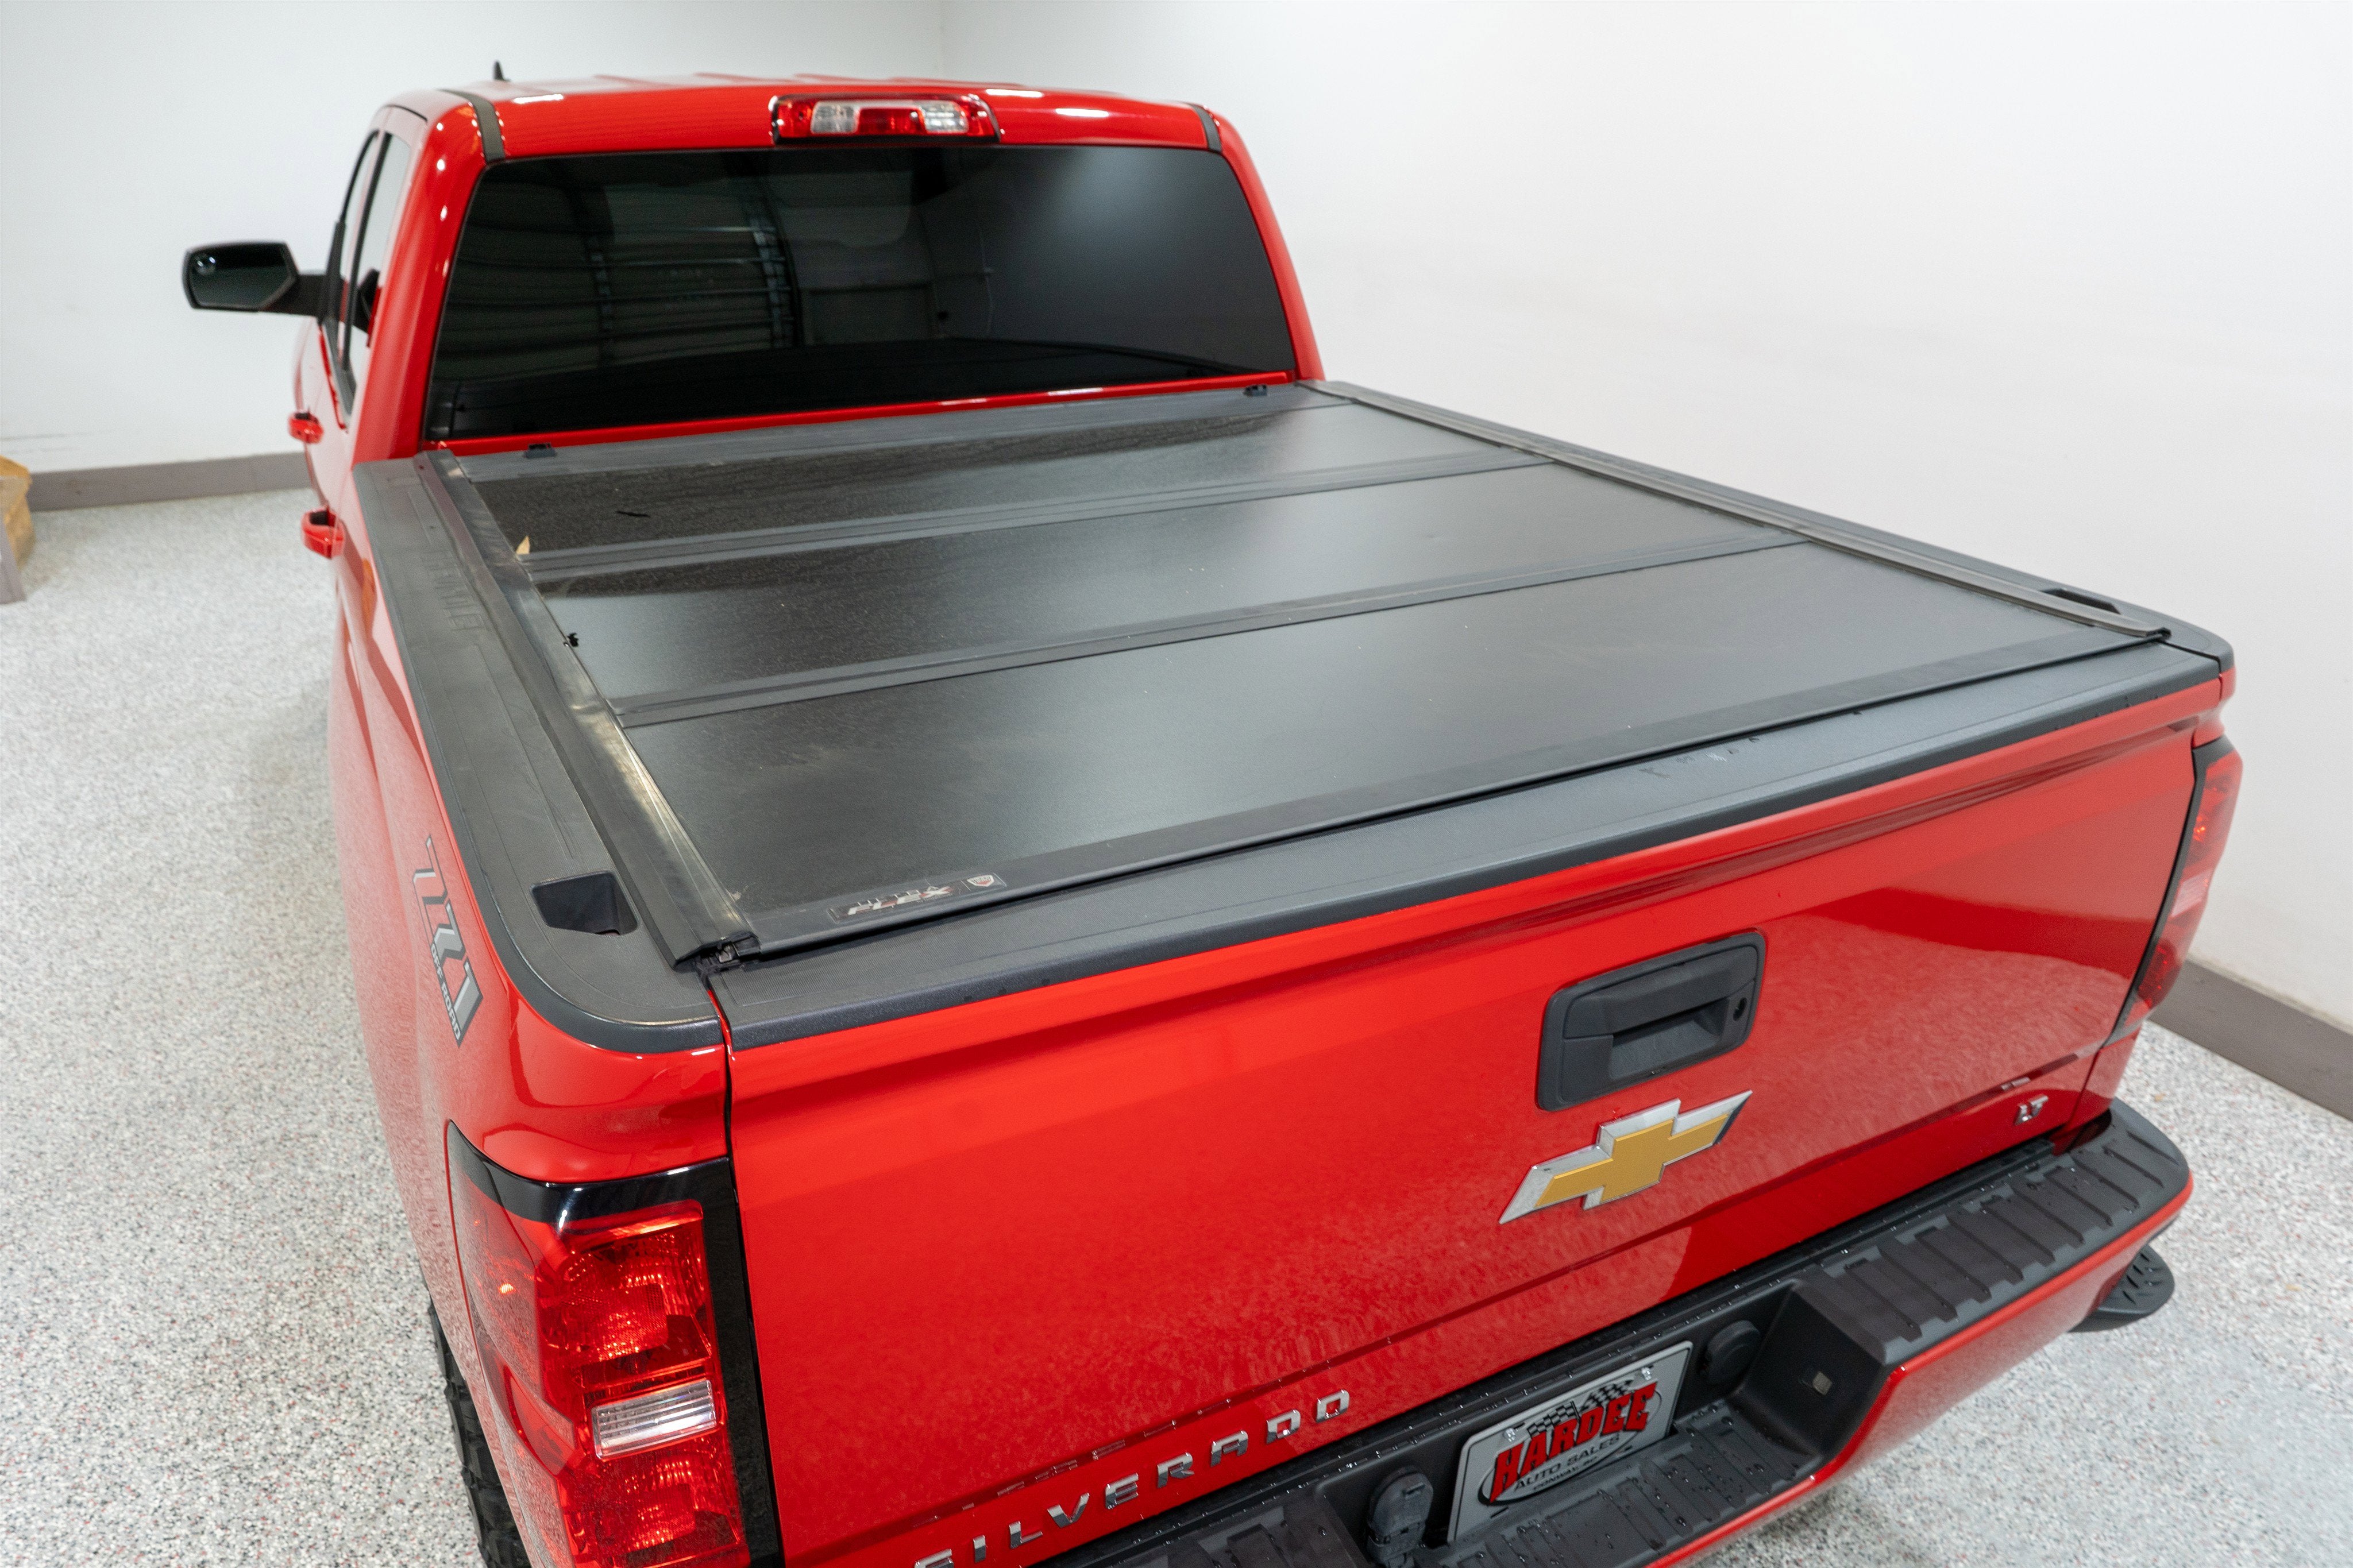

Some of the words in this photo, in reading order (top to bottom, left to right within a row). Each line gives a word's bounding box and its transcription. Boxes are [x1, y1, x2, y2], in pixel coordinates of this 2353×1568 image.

[431, 943, 443, 979] OFF
[441, 981, 461, 1041] ROAD
[2014, 1095, 2049, 1125] LT
[1490, 1380, 1658, 1503] HARDEE
[1513, 1463, 1561, 1492] AUTO
[1567, 1432, 1621, 1466] SALES
